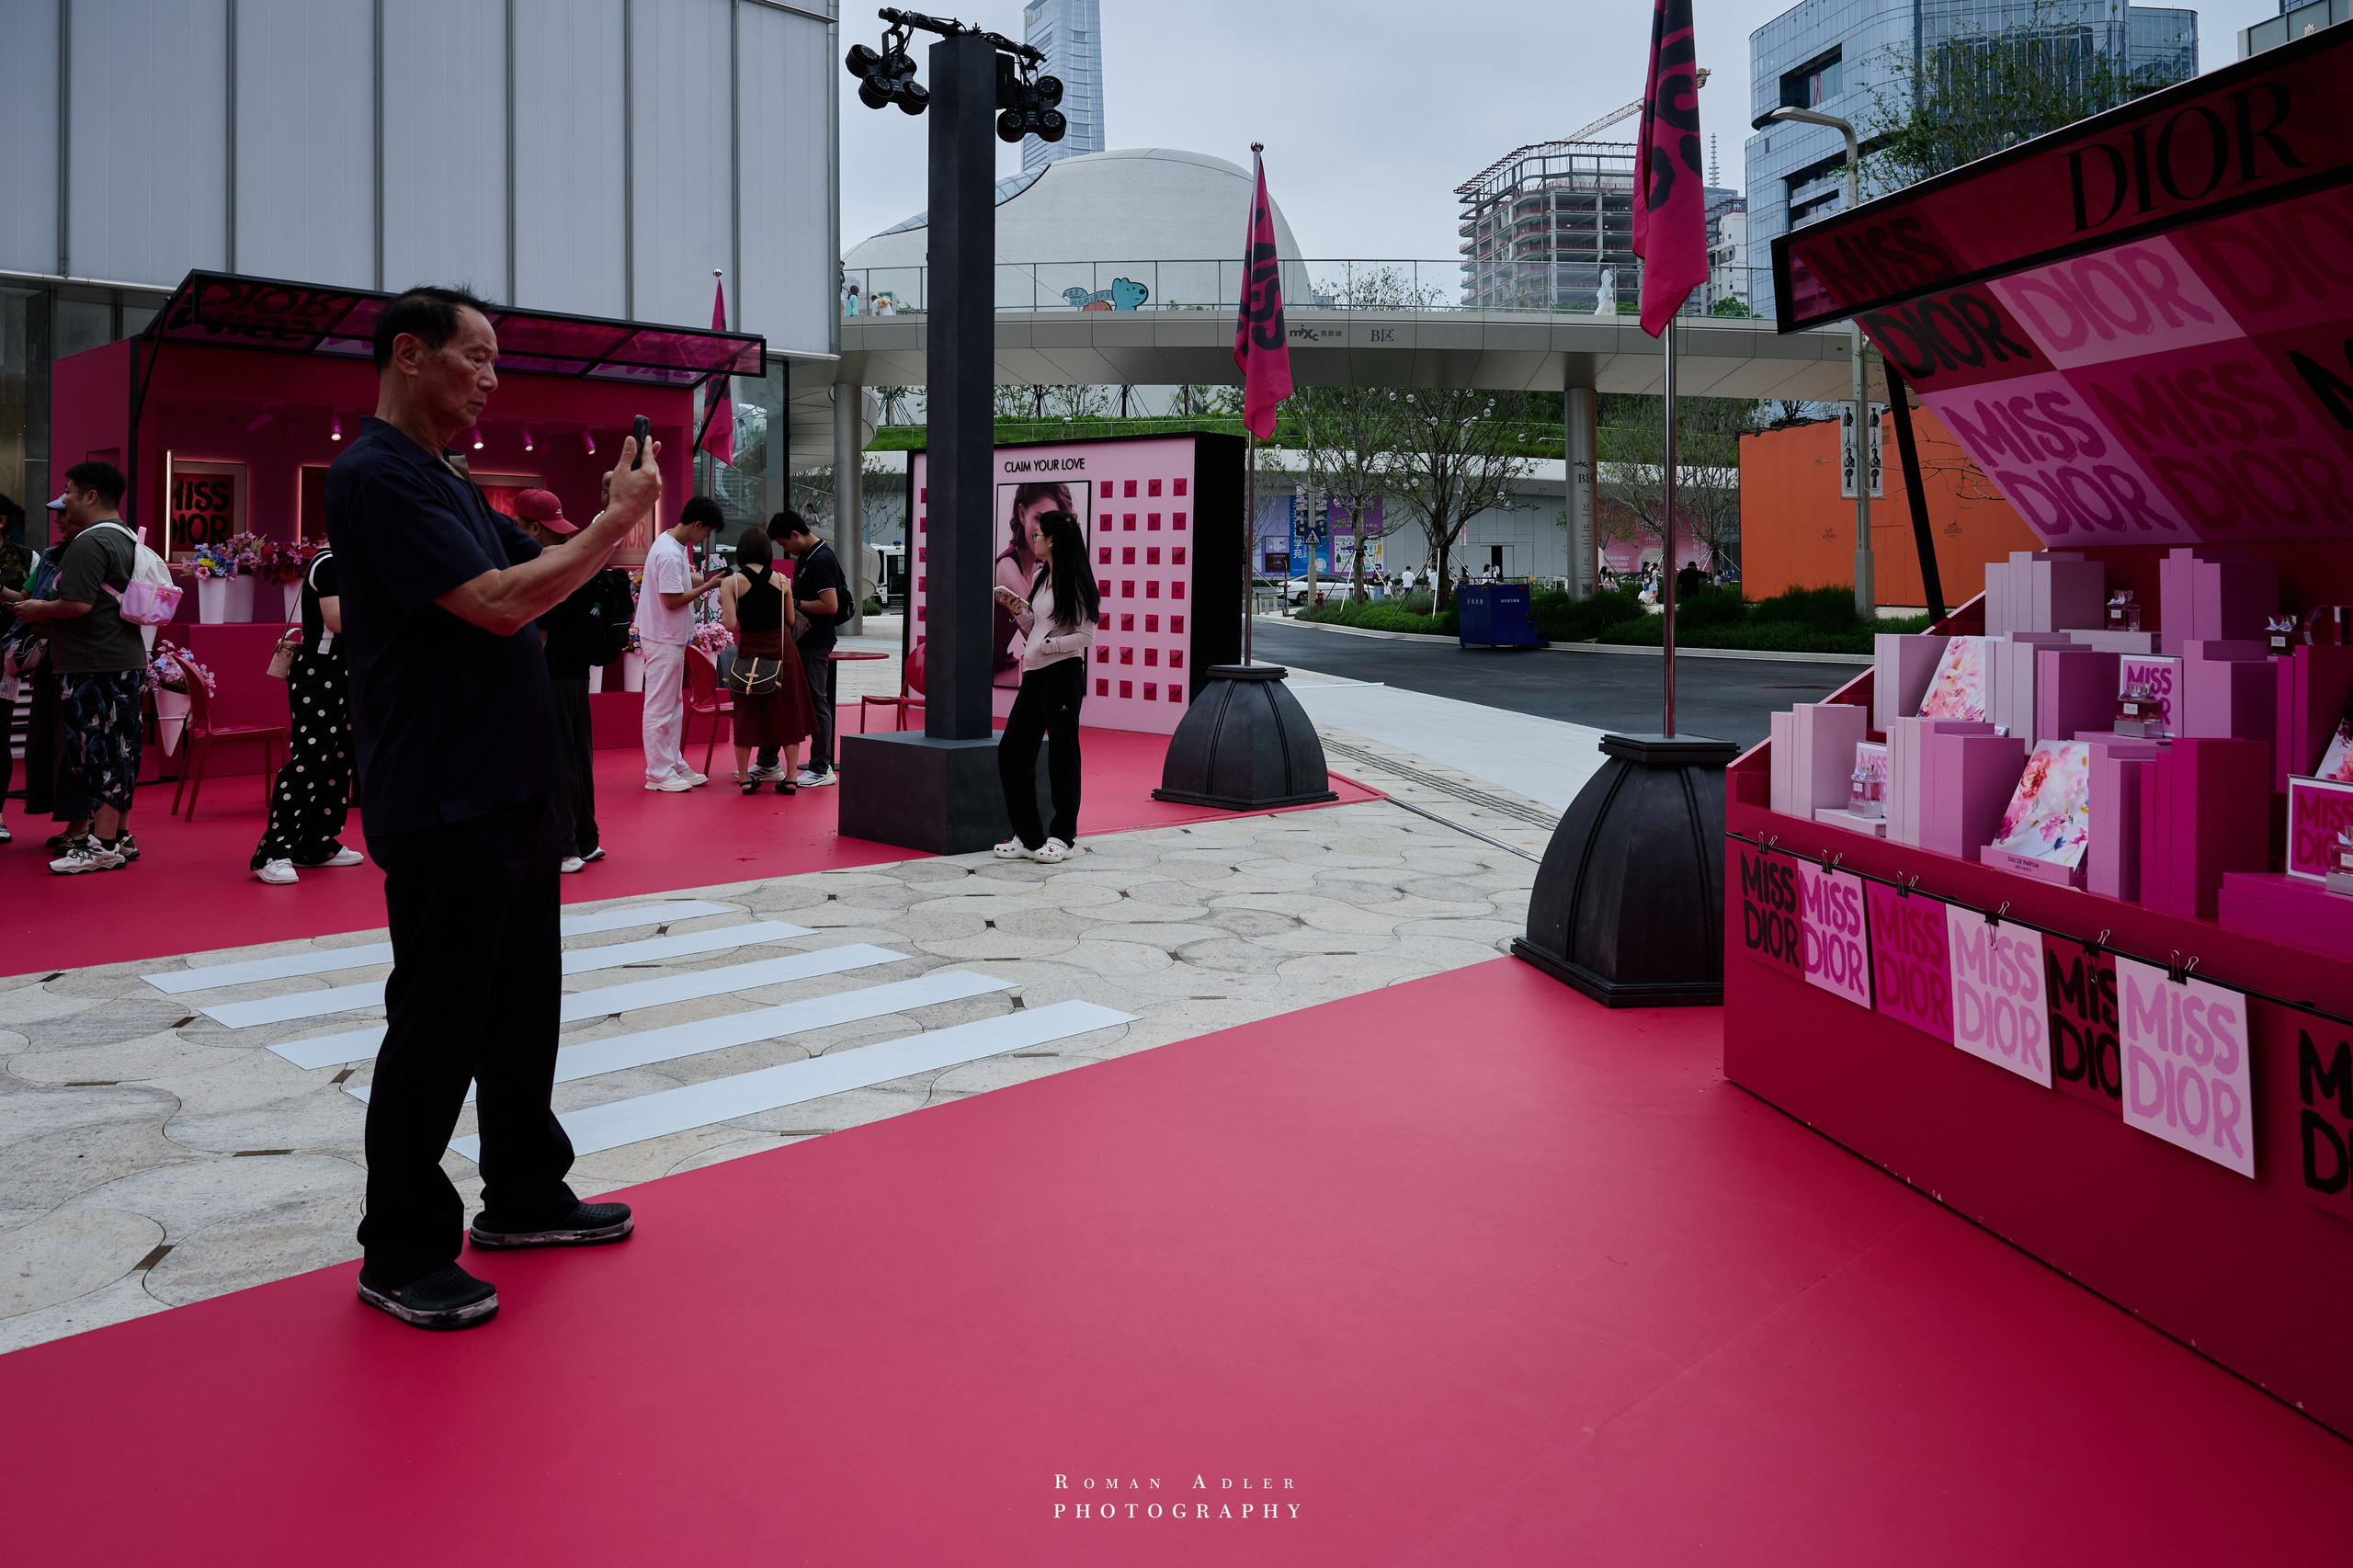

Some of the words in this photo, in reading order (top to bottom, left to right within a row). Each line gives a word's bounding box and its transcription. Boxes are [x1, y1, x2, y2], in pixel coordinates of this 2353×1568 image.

[2061, 83, 2309, 233] DIOR
[1806, 215, 1960, 307] MISS
[2185, 188, 2353, 315] DIO
[1370, 329, 1394, 342] B区
[1861, 292, 2032, 380] DIOR
[2001, 246, 2215, 352] DIOR
[1940, 390, 2107, 467] MISS
[2088, 360, 2299, 452] MISS
[1005, 460, 1031, 472] CLAIM
[1034, 459, 1059, 472] YOUR
[1062, 458, 1085, 470] LOVE
[1995, 464, 2177, 536] DIOR
[2150, 446, 2353, 528] DIOR
[173, 513, 229, 546] IOR
[2127, 665, 2172, 696] MISS
[1741, 851, 1797, 915] MISS
[1800, 869, 1861, 937] MISS
[2023, 859, 2040, 869] PARFUM
[1744, 899, 1800, 970] DIOR
[1802, 921, 1865, 996] DIOR
[1872, 893, 1944, 967] MISS
[1953, 919, 2039, 1003] MISS
[1877, 949, 1950, 1033] DIOR
[1957, 980, 2044, 1074] DIOR
[2047, 949, 2119, 1033] MIS
[2126, 974, 2240, 1074] MISS
[2052, 1013, 2121, 1100] DIO
[2128, 1043, 2244, 1159] DIOR
